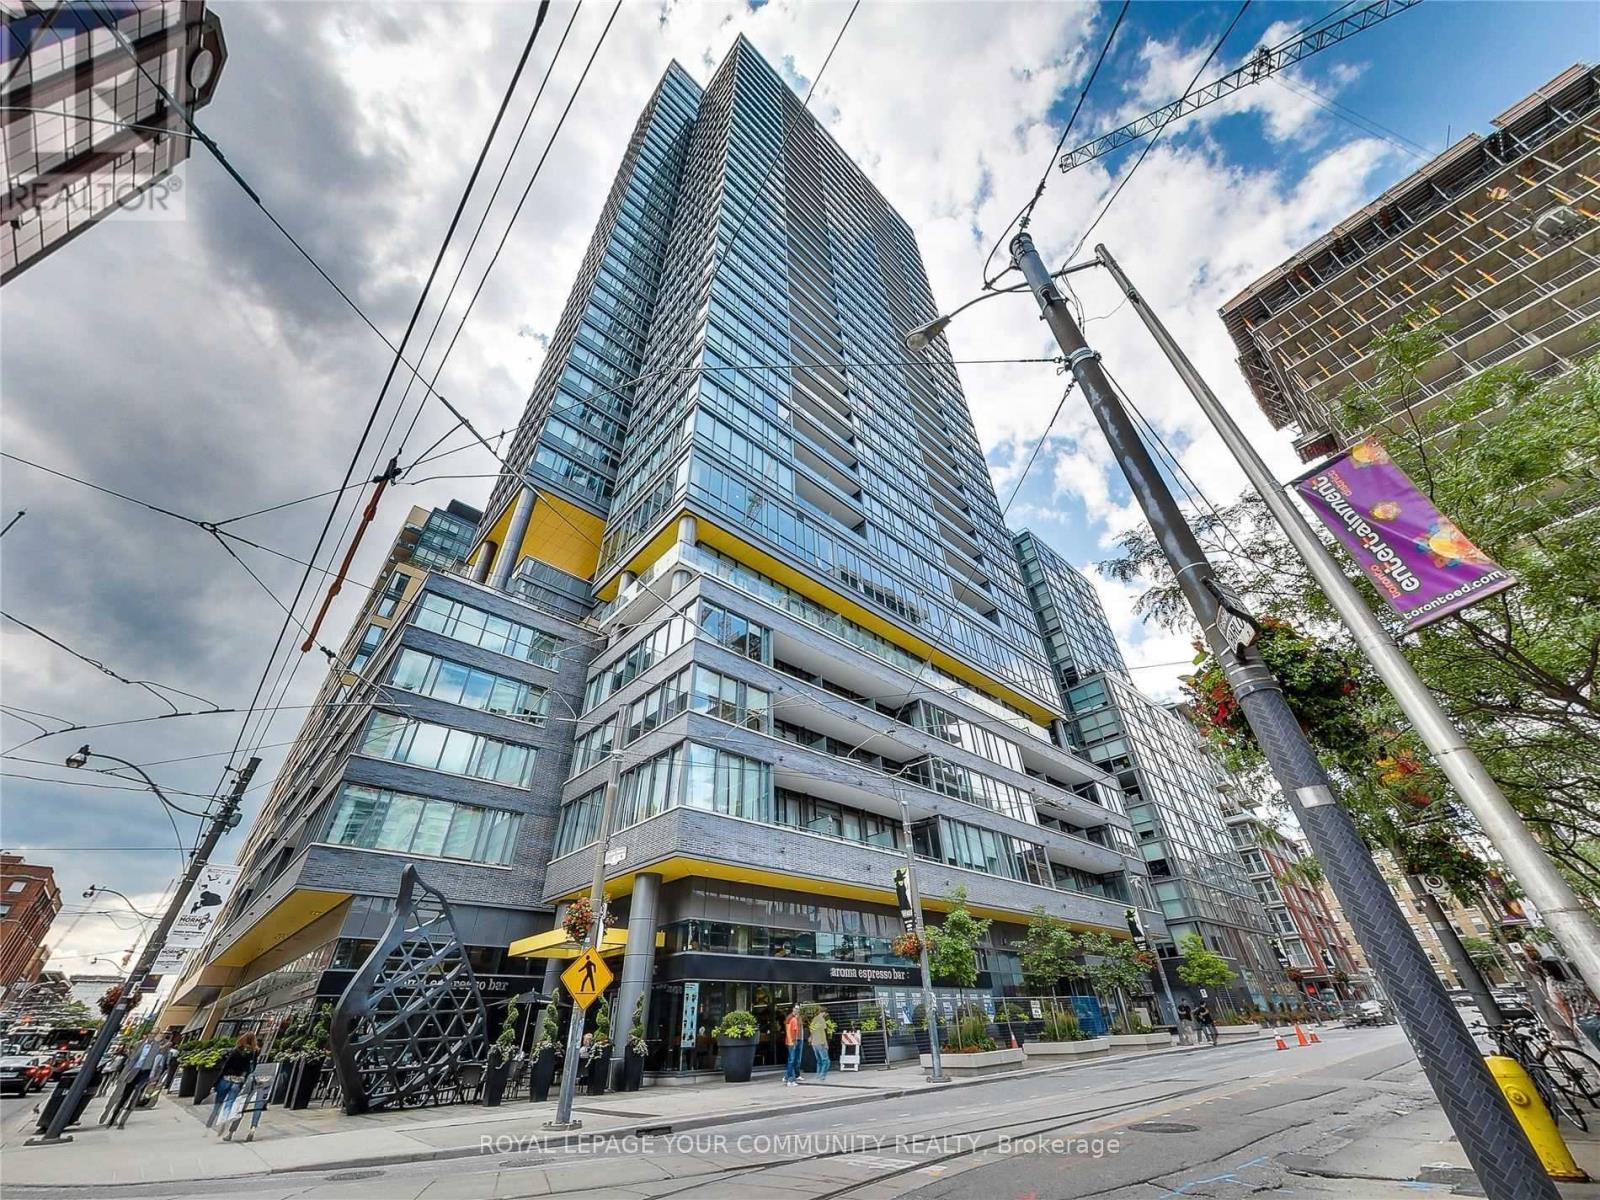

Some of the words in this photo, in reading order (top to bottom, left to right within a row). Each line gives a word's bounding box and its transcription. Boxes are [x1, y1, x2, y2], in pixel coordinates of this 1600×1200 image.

[1311, 475, 1420, 592] entertainment
[1370, 564, 1401, 600] toronto
[1402, 569, 1507, 621] torontoed.com
[487, 978, 510, 991] bar
[830, 967, 858, 978] aroma
[858, 968, 893, 982] espresso
[892, 968, 906, 980] bar
